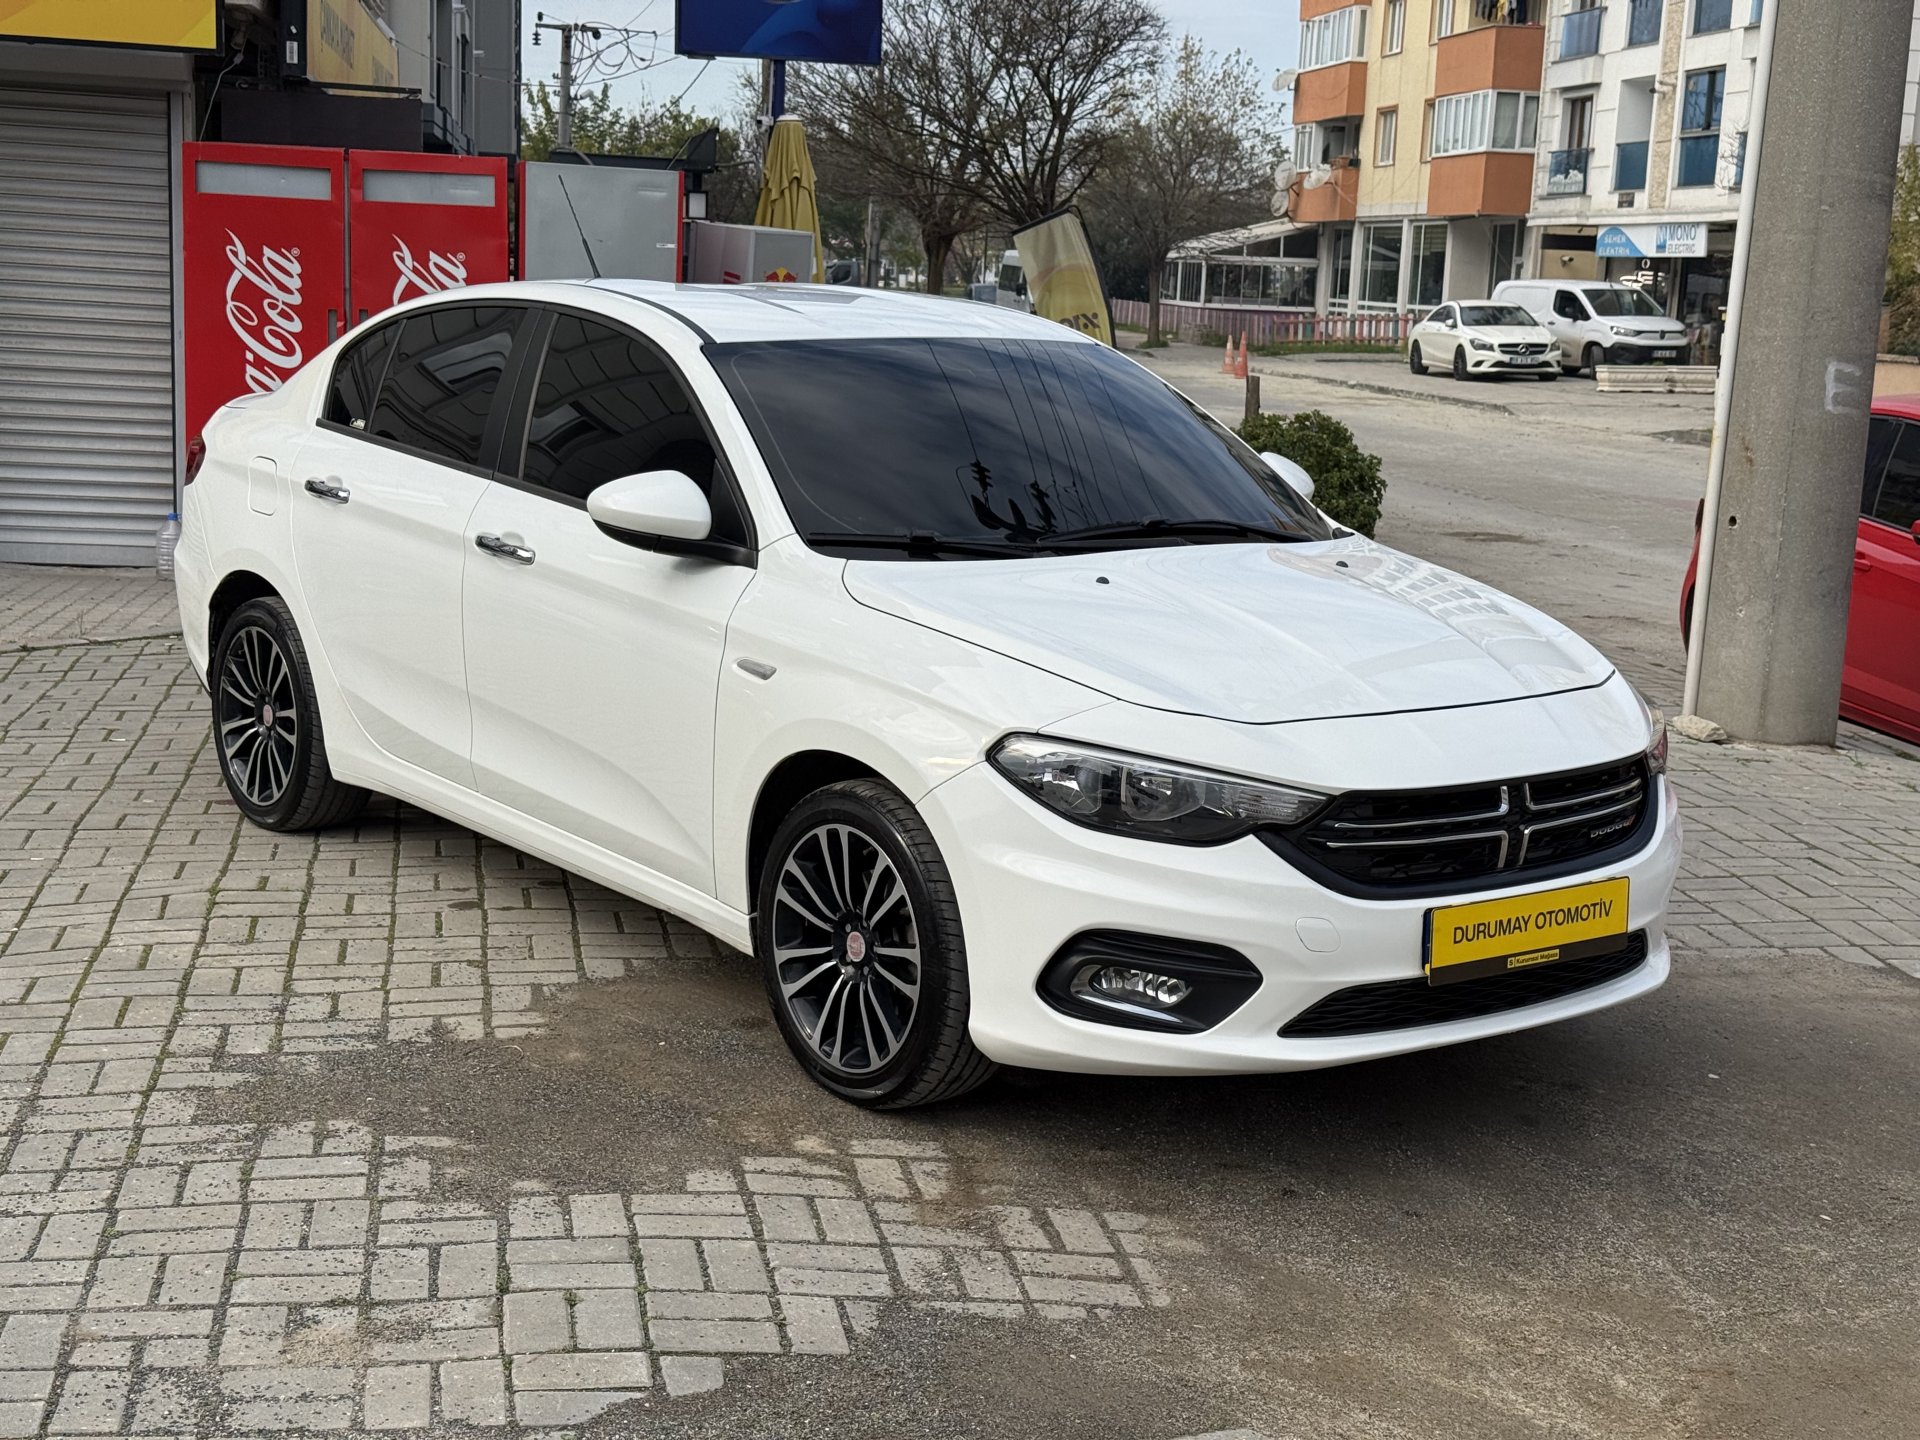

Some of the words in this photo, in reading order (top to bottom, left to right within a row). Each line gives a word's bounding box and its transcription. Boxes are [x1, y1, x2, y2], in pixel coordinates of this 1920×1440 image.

[1667, 243, 1696, 255] ELECTRIC
[1668, 223, 1697, 241] MONO
[225, 228, 302, 393] a-Cola
[1824, 361, 1861, 414] E
[1453, 914, 1532, 945] DURUMAY
[1535, 898, 1613, 930] OTOMOTİV
